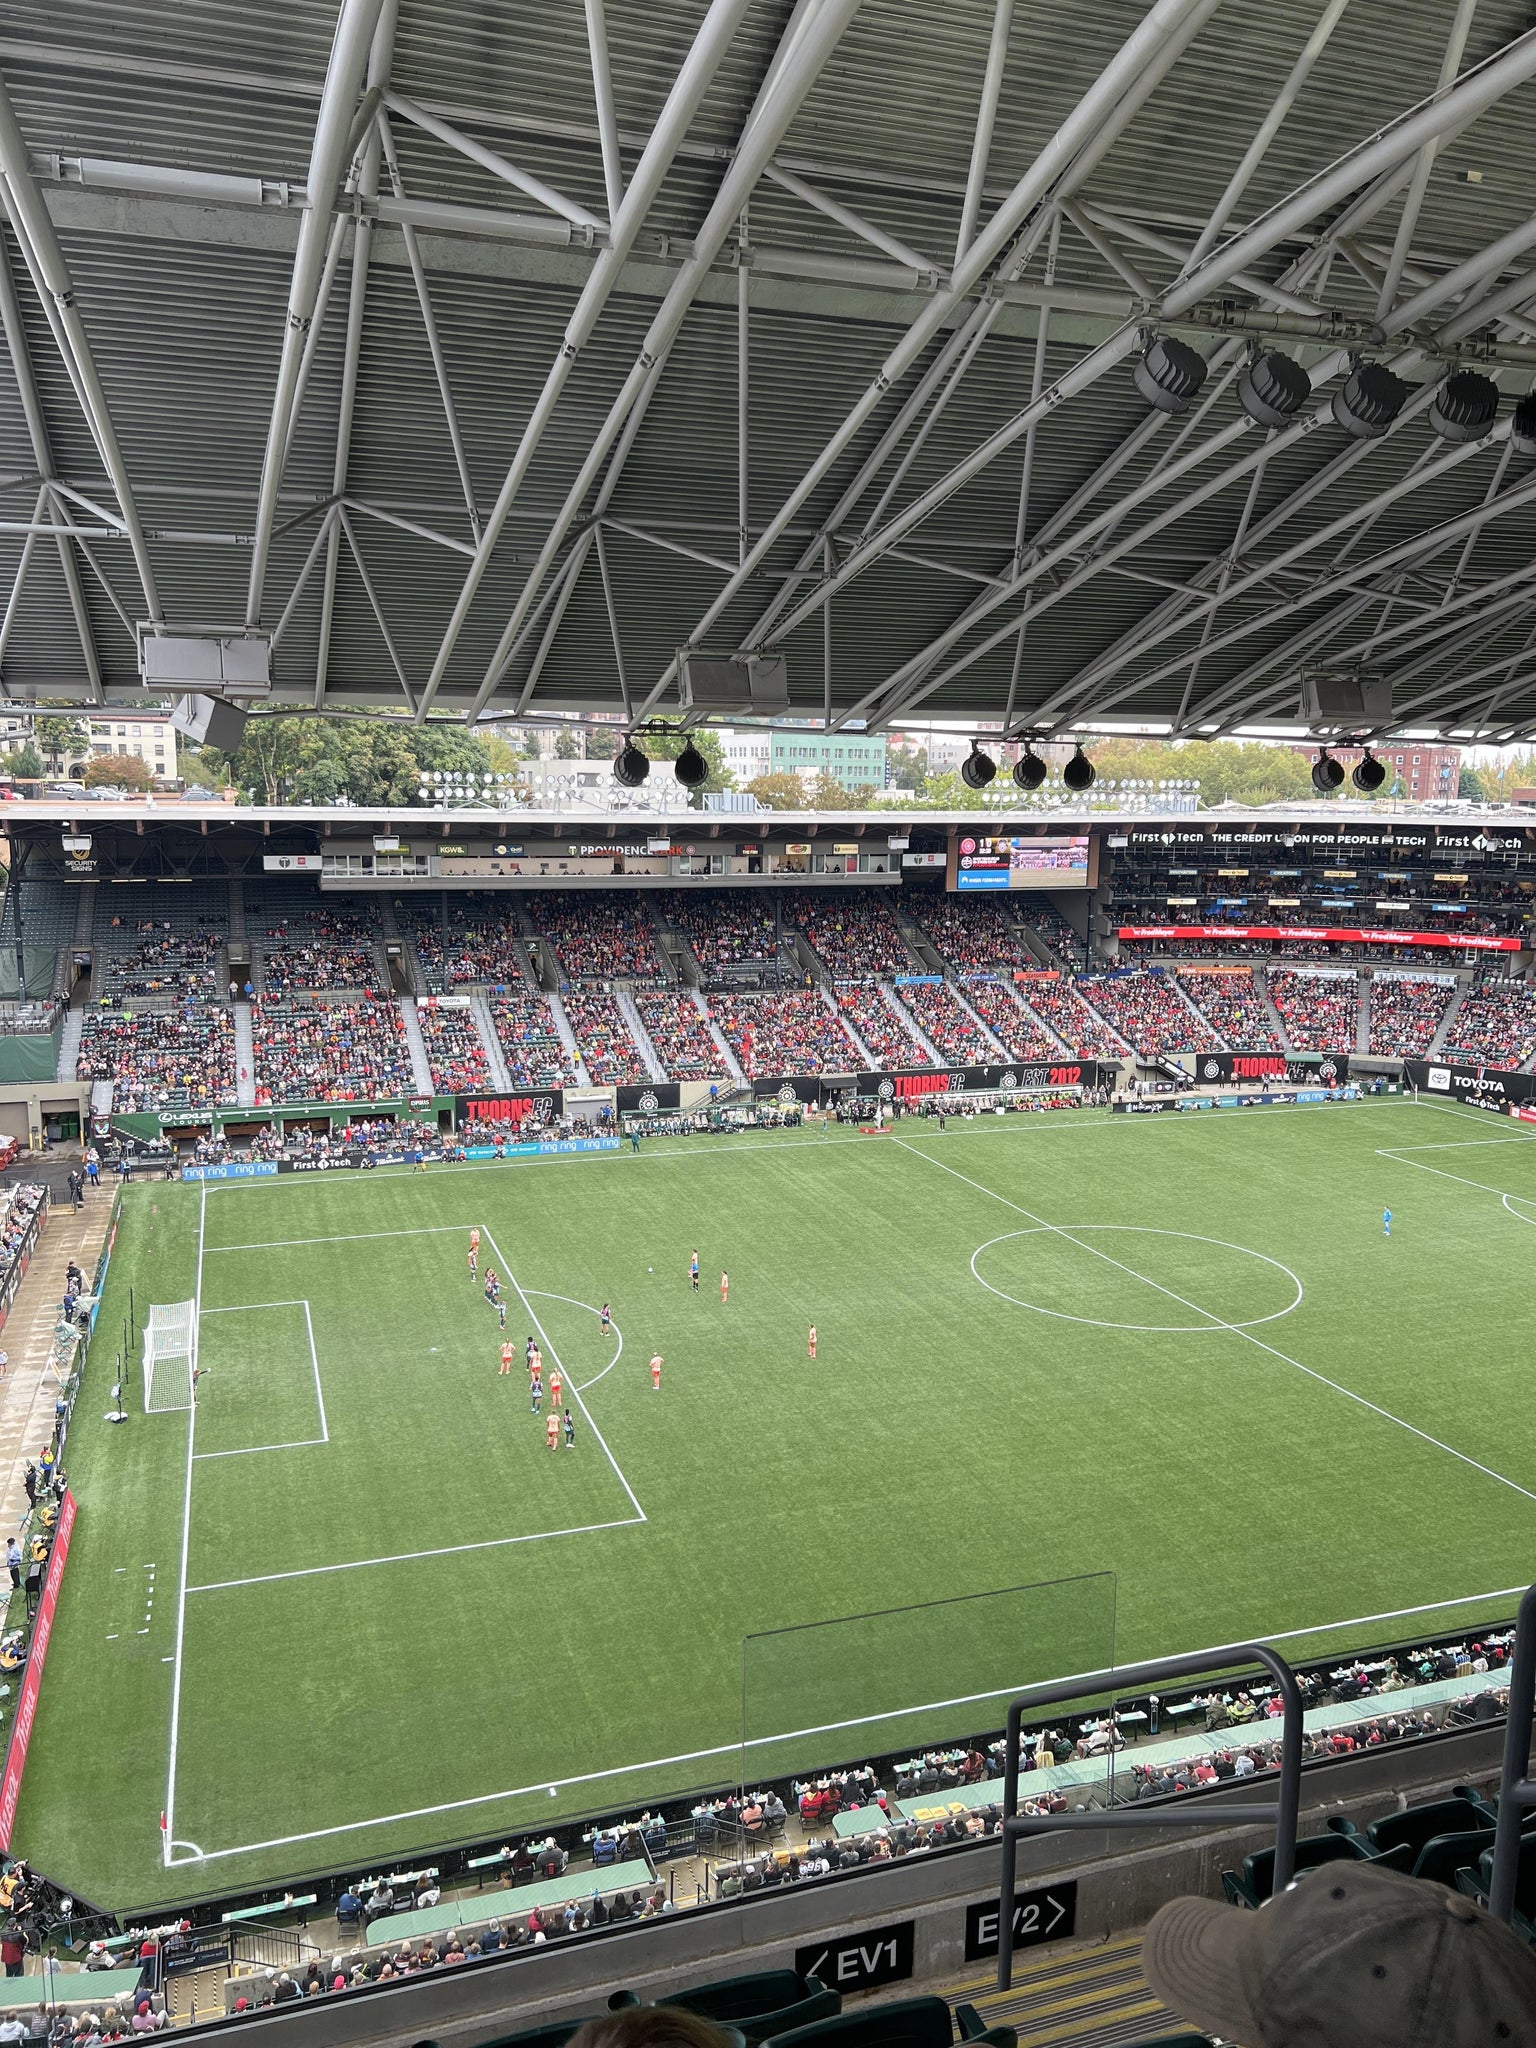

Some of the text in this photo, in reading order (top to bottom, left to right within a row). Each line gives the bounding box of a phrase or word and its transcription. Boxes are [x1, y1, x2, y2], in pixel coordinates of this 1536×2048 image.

[1132, 833, 1204, 843] First Tech
[1212, 833, 1232, 843] THE
[1234, 833, 1273, 843] CREDIT
[1274, 834, 1311, 844] UON
[1312, 835, 1335, 844] FOR
[1337, 835, 1380, 845] PEOPLE
[1396, 836, 1427, 846] TECH
[1436, 836, 1470, 847] First
[1049, 1066, 1082, 1085] 2012
[1232, 1057, 1288, 1078] THORNS
[894, 1074, 948, 1098] THORNS
[1453, 1076, 1505, 1093] TOYOTA
[466, 1098, 533, 1122] THORNS
[1465, 1096, 1501, 1111] First Tech
[173, 1112, 213, 1120] LEXUS
[540, 1137, 619, 1153] ring ring ring ring
[184, 1162, 277, 1179] ring ring ring ring
[293, 1158, 351, 1170] First Tech
[32, 1614, 51, 1674] TYLENOL
[15, 1682, 37, 1755] TYLENOL
[807, 1860, 821, 1872] 96
[837, 1938, 898, 1981] EV1
